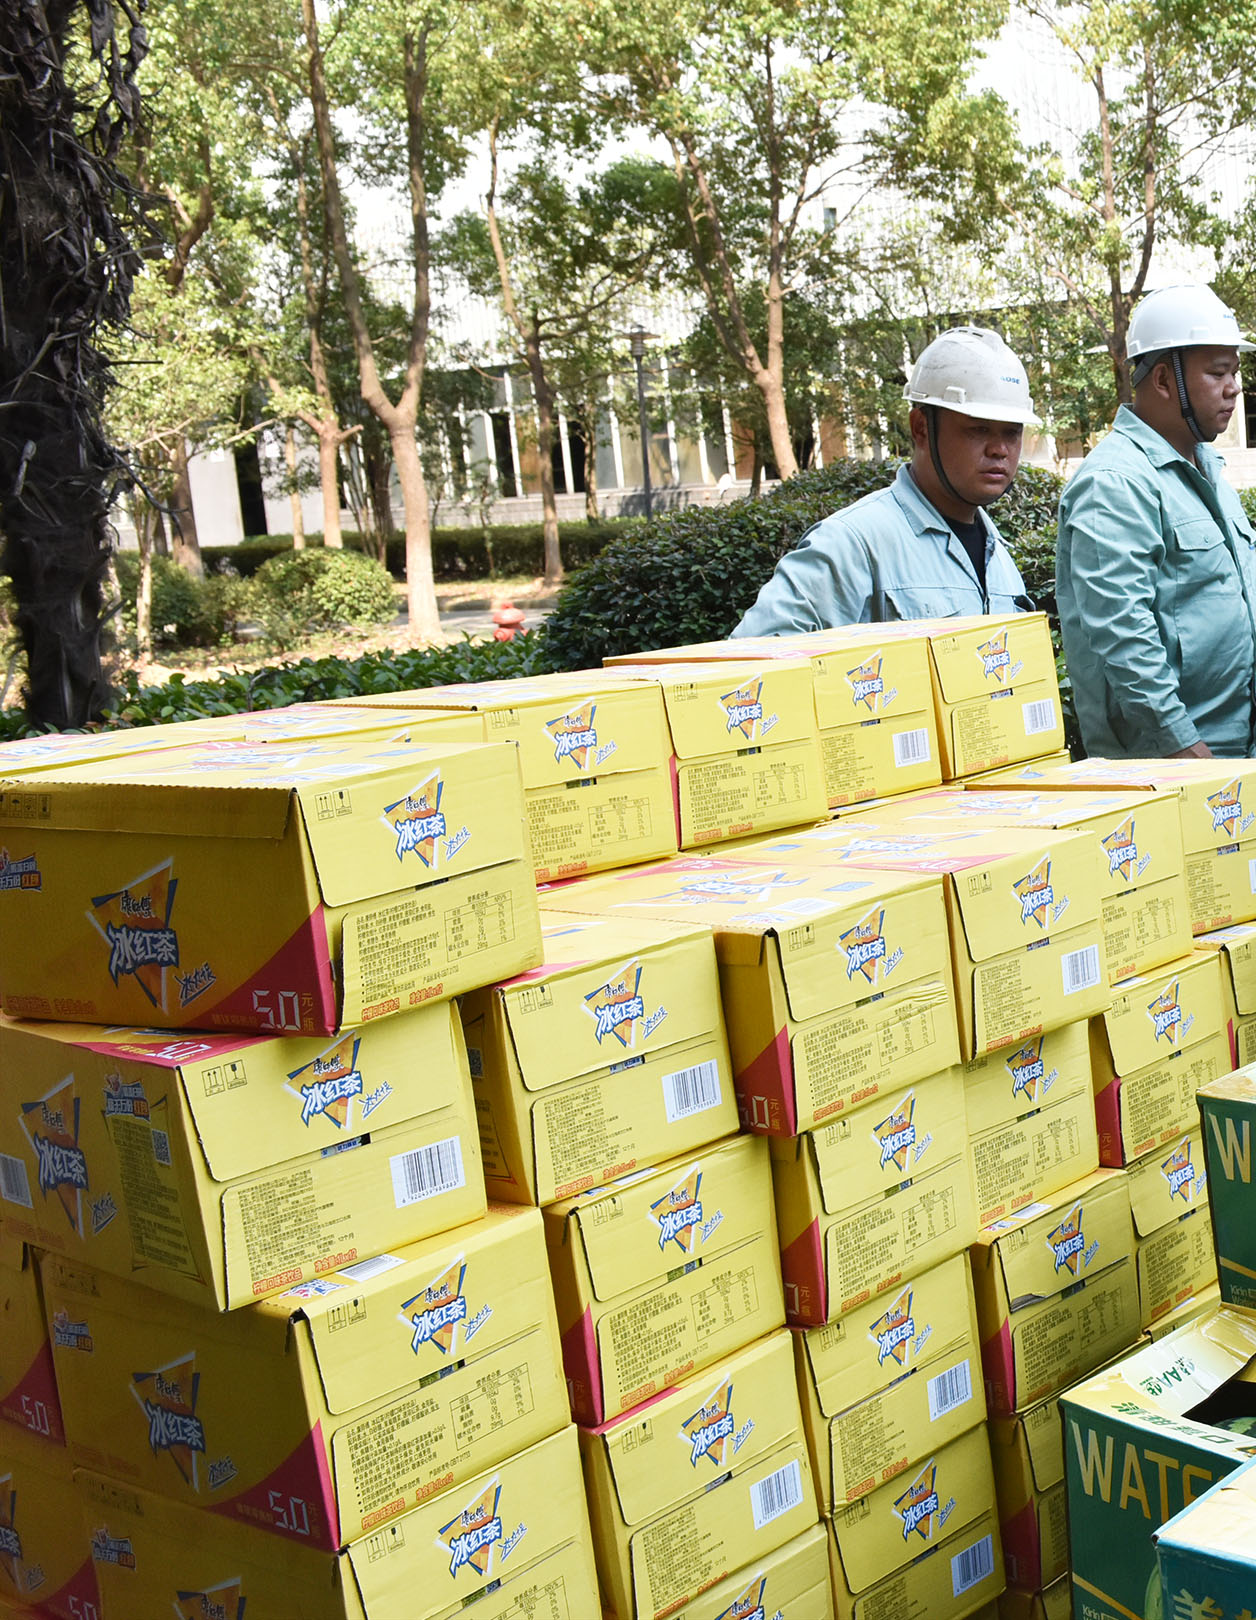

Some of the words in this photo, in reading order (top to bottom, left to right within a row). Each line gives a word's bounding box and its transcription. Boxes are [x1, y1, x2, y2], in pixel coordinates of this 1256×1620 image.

[395, 812, 446, 862] 冰红茶
[108, 924, 179, 987] 冰红茶
[594, 995, 644, 1046] 冰红茶
[300, 1069, 363, 1128] 冰红茶
[34, 1131, 89, 1200] 冰红茶
[658, 1200, 703, 1252] 冰红茶
[412, 1296, 467, 1355] 冰红茶
[145, 1398, 205, 1459] 冰红茶
[690, 1413, 734, 1468] 冰红茶
[448, 1516, 502, 1579] 冰红茶
